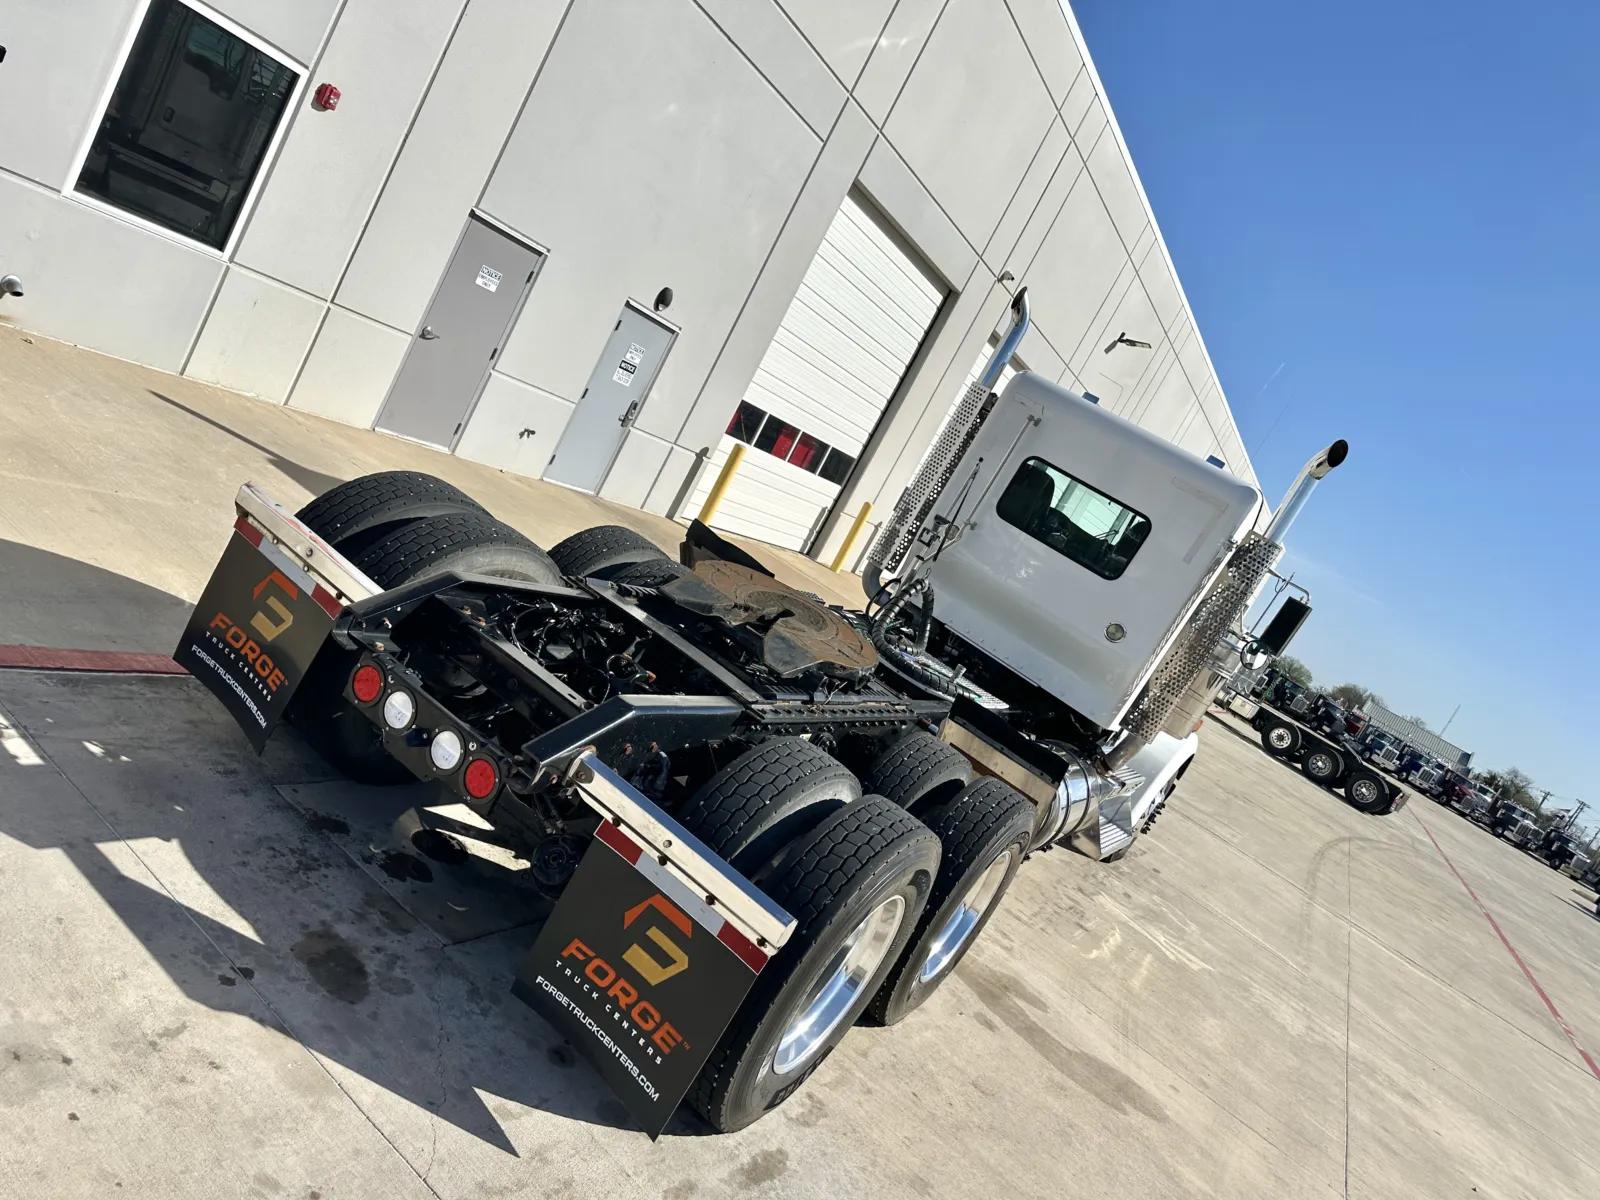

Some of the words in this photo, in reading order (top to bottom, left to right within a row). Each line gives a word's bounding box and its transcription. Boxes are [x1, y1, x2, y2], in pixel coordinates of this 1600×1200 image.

[191, 644, 268, 729] FORGETRUCKCENTERS.COM
[205, 631, 236, 660] TRUCK
[238, 661, 272, 702] CENTERS
[535, 975, 660, 1102] FORGETRUCKCENTERS.COM
[555, 960, 599, 1000] TRUCK
[605, 1004, 662, 1065] CENTERS
